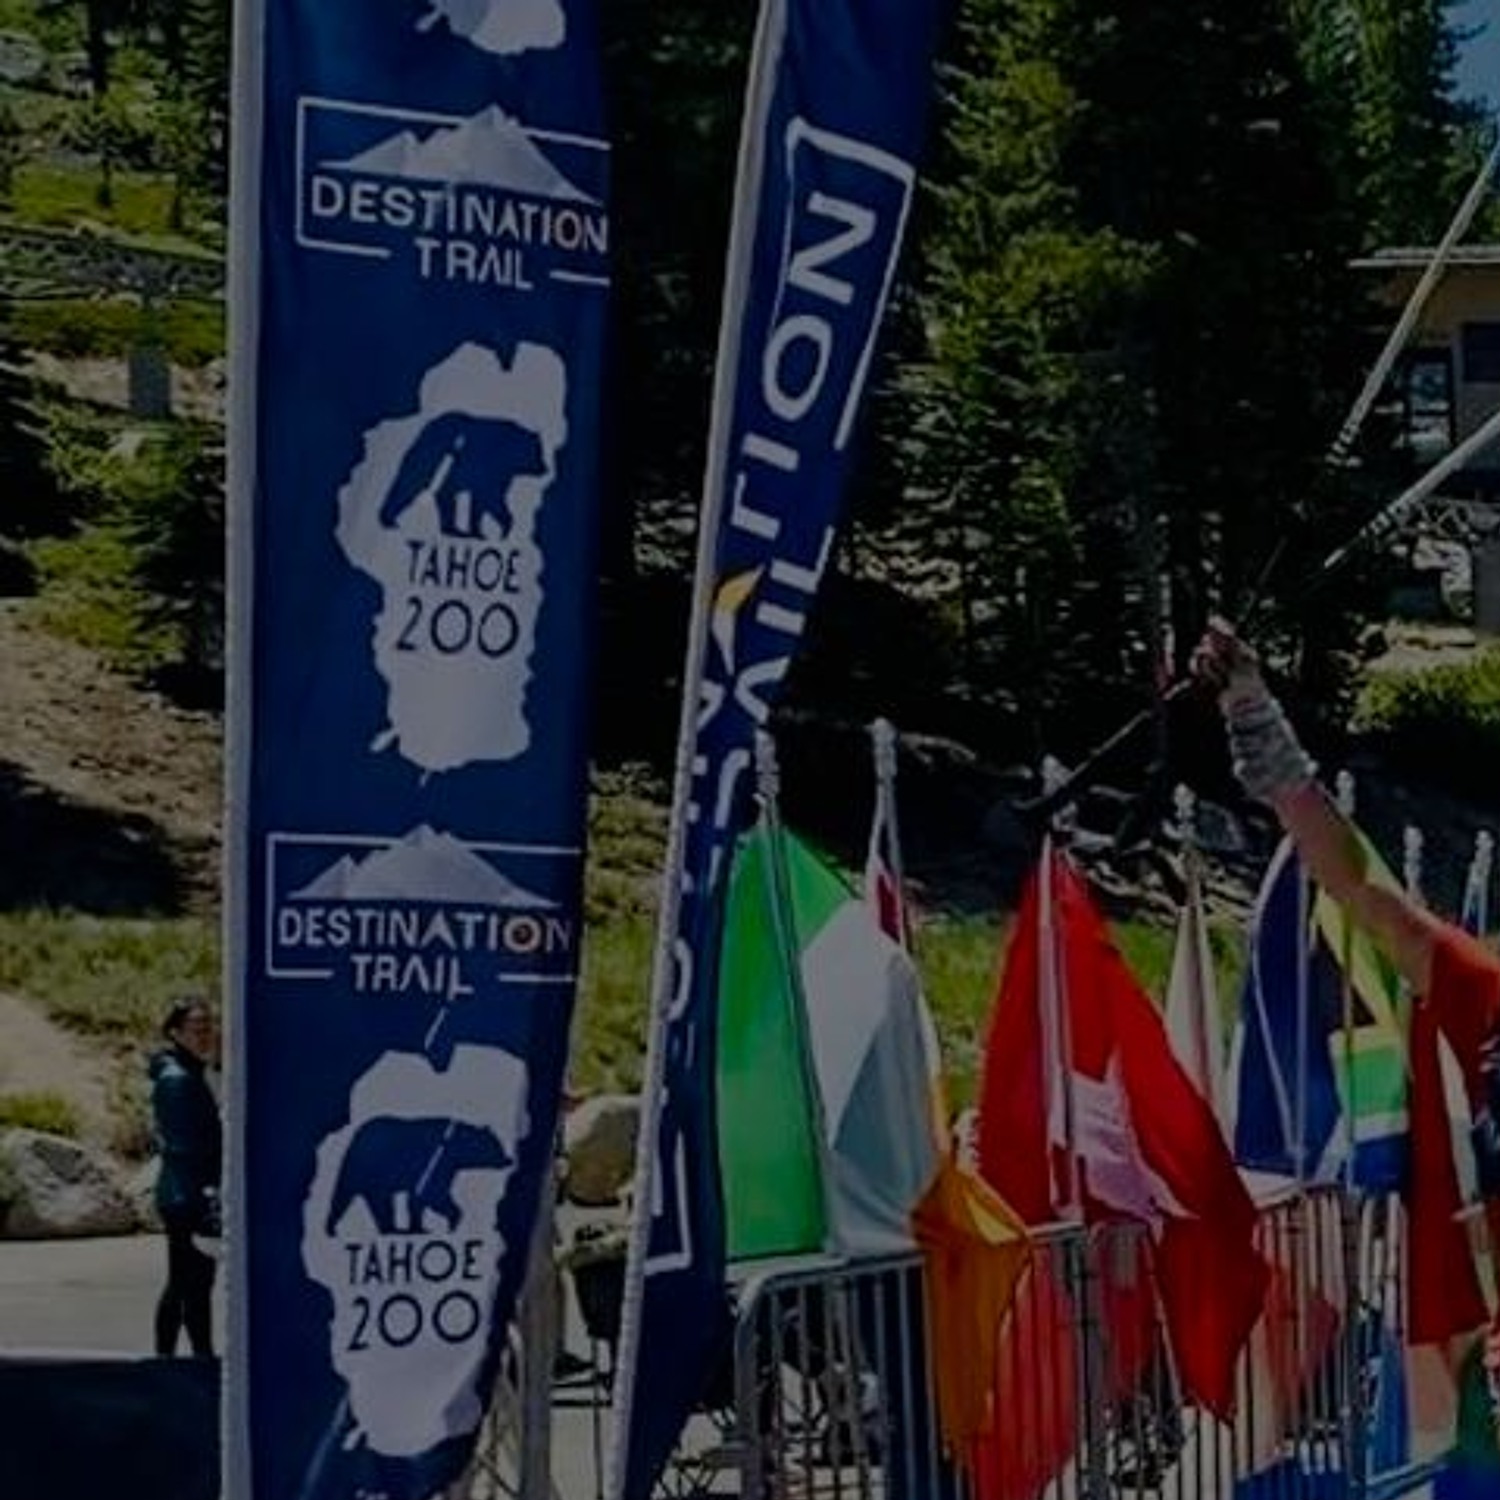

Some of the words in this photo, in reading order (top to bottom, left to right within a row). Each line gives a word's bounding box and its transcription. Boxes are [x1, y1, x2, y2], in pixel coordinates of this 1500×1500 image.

[310, 174, 610, 253] DESTINATION
[414, 238, 535, 292] TRAIL
[406, 540, 521, 595] TAHOE
[394, 599, 520, 658] 200
[277, 904, 575, 954] DESTINATION
[350, 952, 475, 998] TRAIL
[344, 1238, 485, 1287] TAHOE
[348, 1290, 481, 1351] 200
